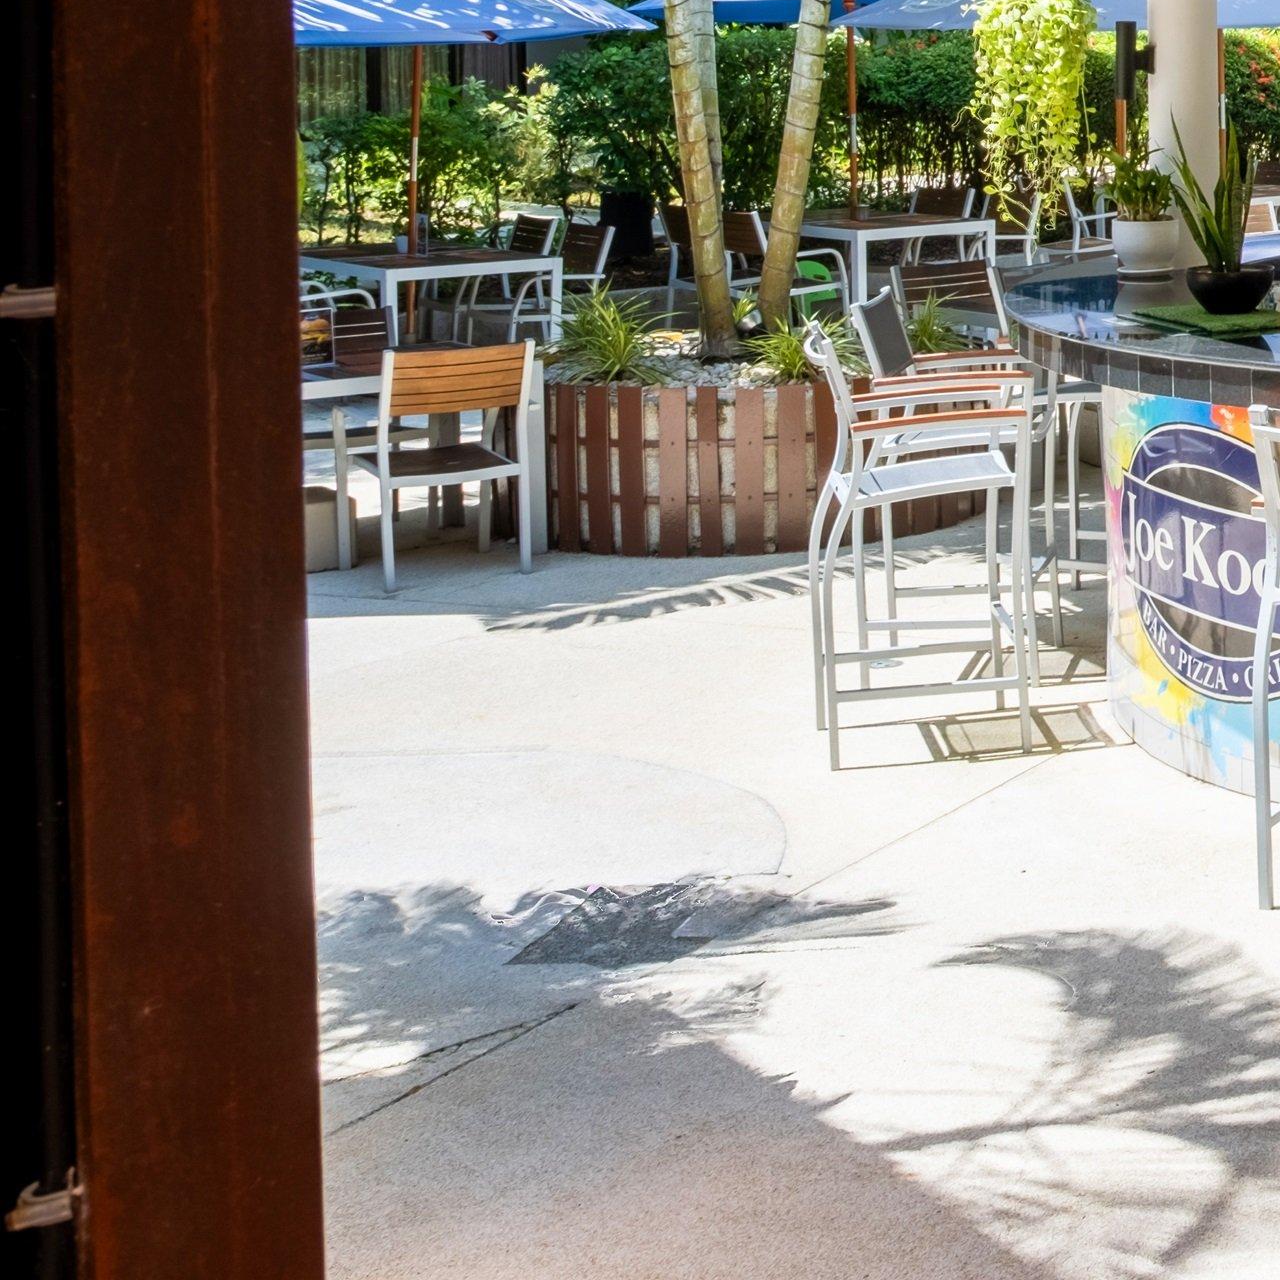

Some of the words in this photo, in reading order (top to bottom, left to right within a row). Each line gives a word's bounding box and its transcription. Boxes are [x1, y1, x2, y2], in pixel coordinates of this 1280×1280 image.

[1126, 491, 1174, 573] Joe
[1142, 598, 1169, 653] BAR
[1177, 652, 1228, 692] PIZZA
